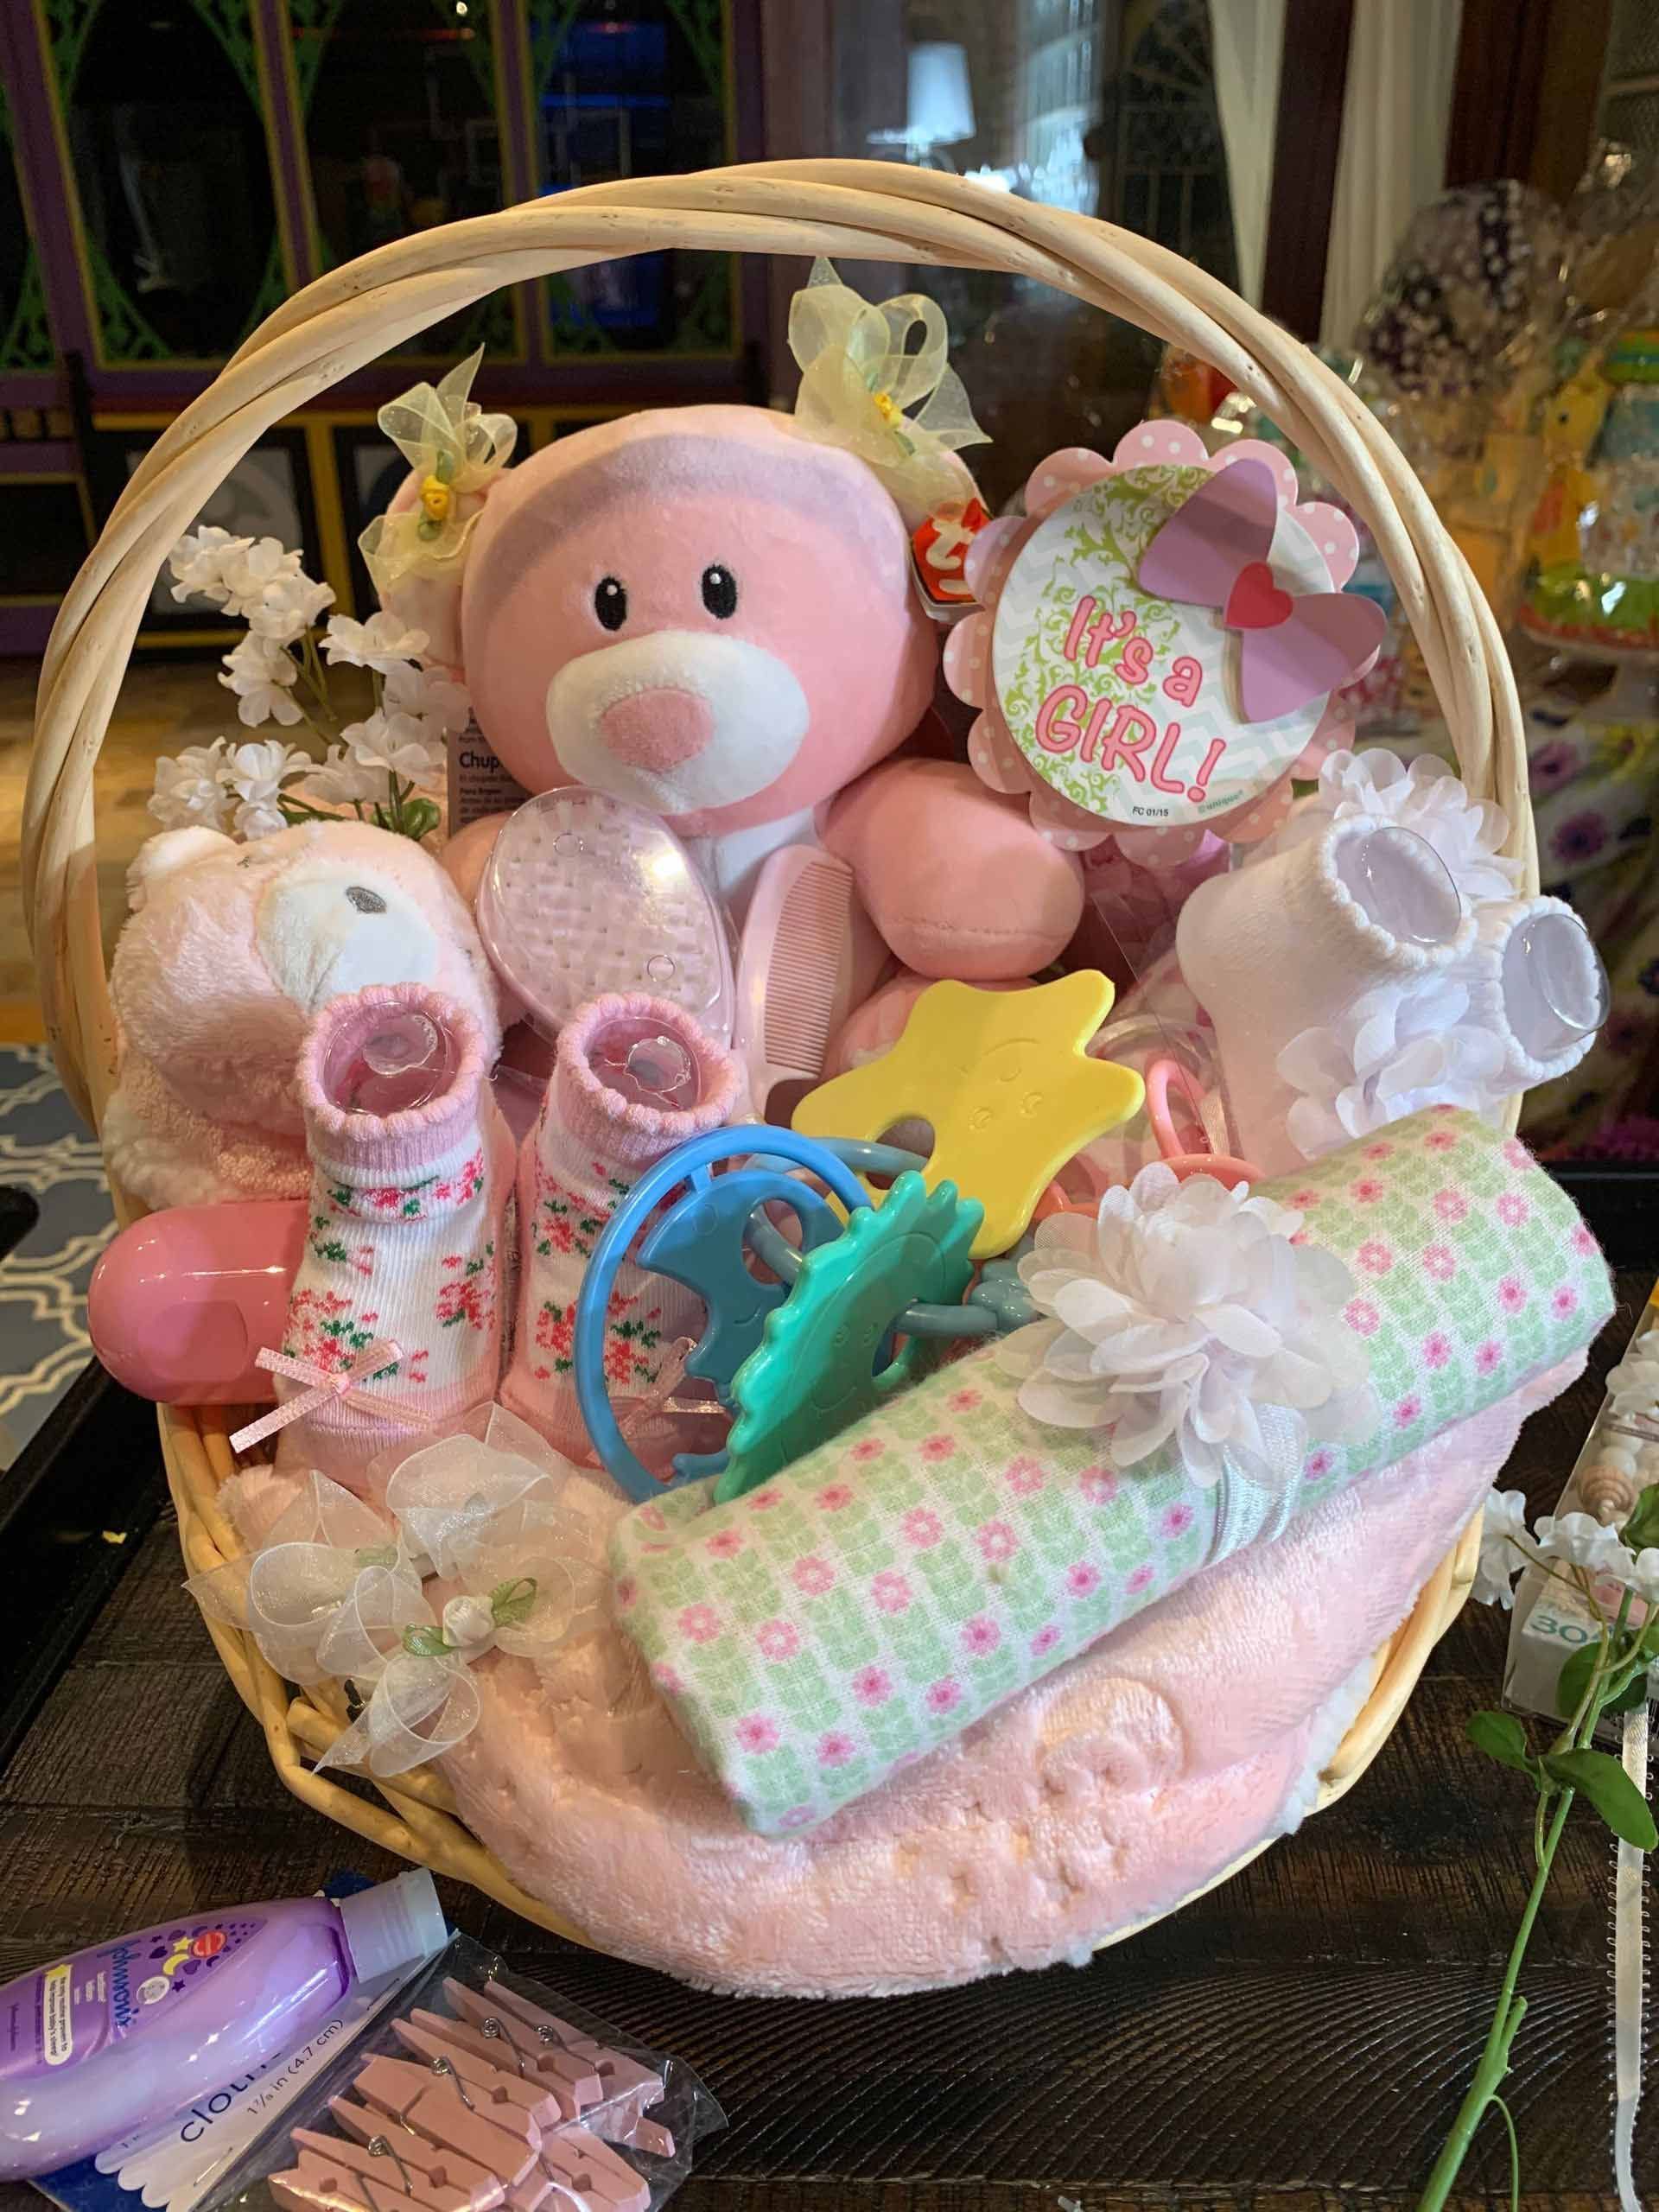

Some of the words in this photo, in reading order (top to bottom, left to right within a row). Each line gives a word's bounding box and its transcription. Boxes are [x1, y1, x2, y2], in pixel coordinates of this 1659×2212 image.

[1064, 595, 1154, 685] It's
[1162, 656, 1203, 708] a
[1036, 684, 1227, 803] GIRL!
[1132, 806, 1145, 817] FC
[1146, 808, 1169, 817] 01/15
[270, 2076, 289, 2091] in
[288, 2046, 314, 2075] (4.7
[316, 2019, 344, 2045] cm)
